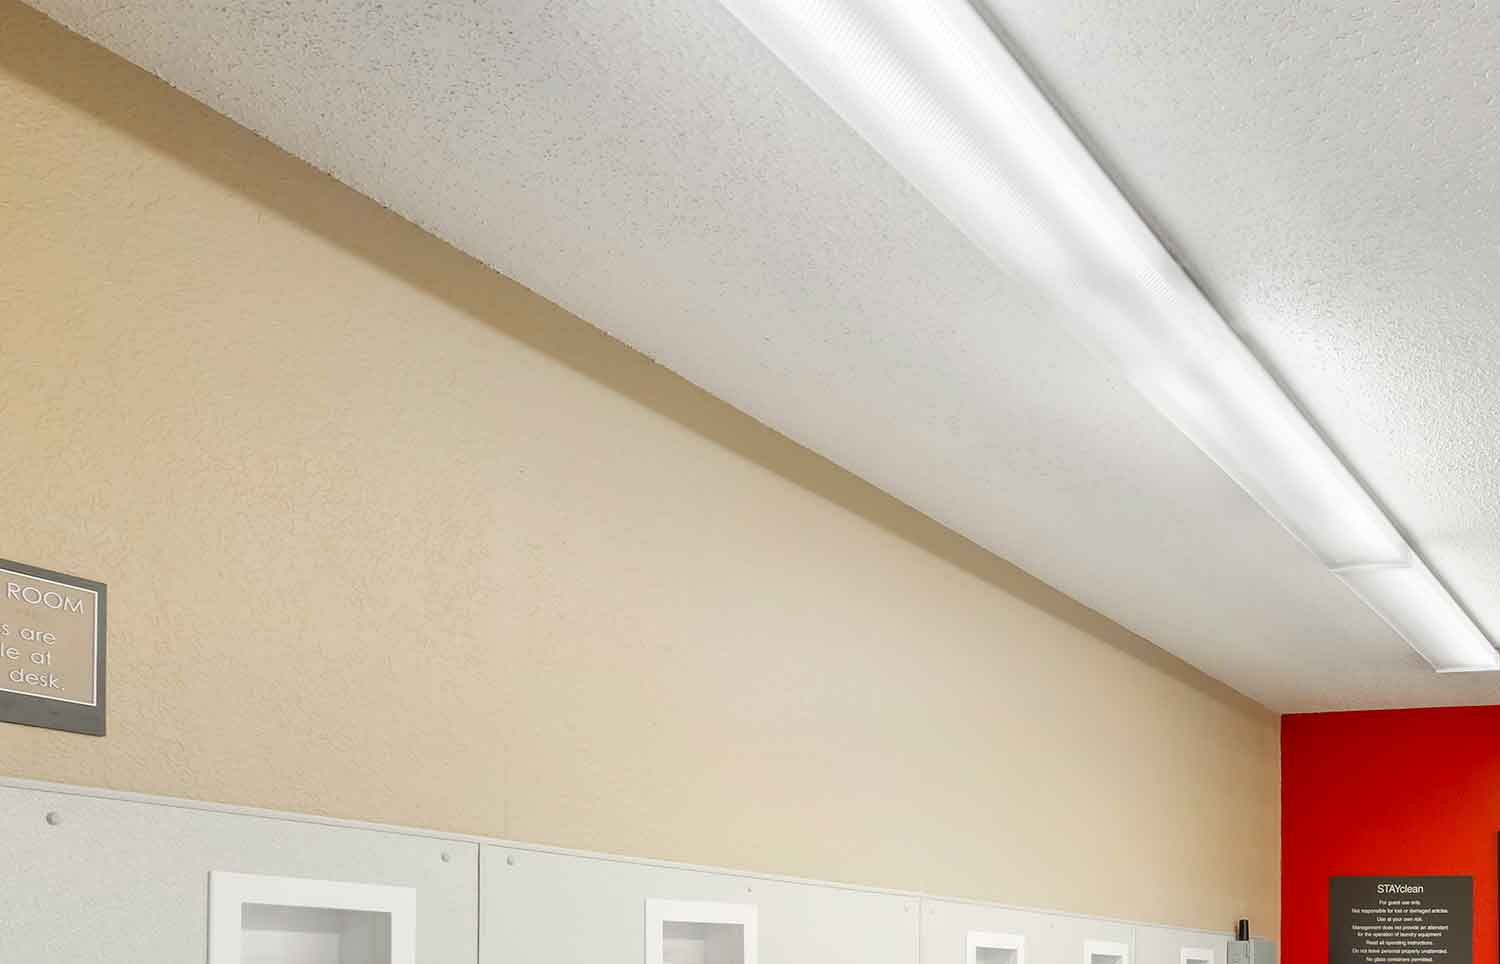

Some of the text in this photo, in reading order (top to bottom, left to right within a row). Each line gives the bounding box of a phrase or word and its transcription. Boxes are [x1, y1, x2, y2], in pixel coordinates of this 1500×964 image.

[7, 582, 84, 615] ROOM
[20, 627, 57, 645] are
[31, 650, 52, 665] at
[9, 668, 65, 691] desk.
[1377, 884, 1424, 893] STAYclean
